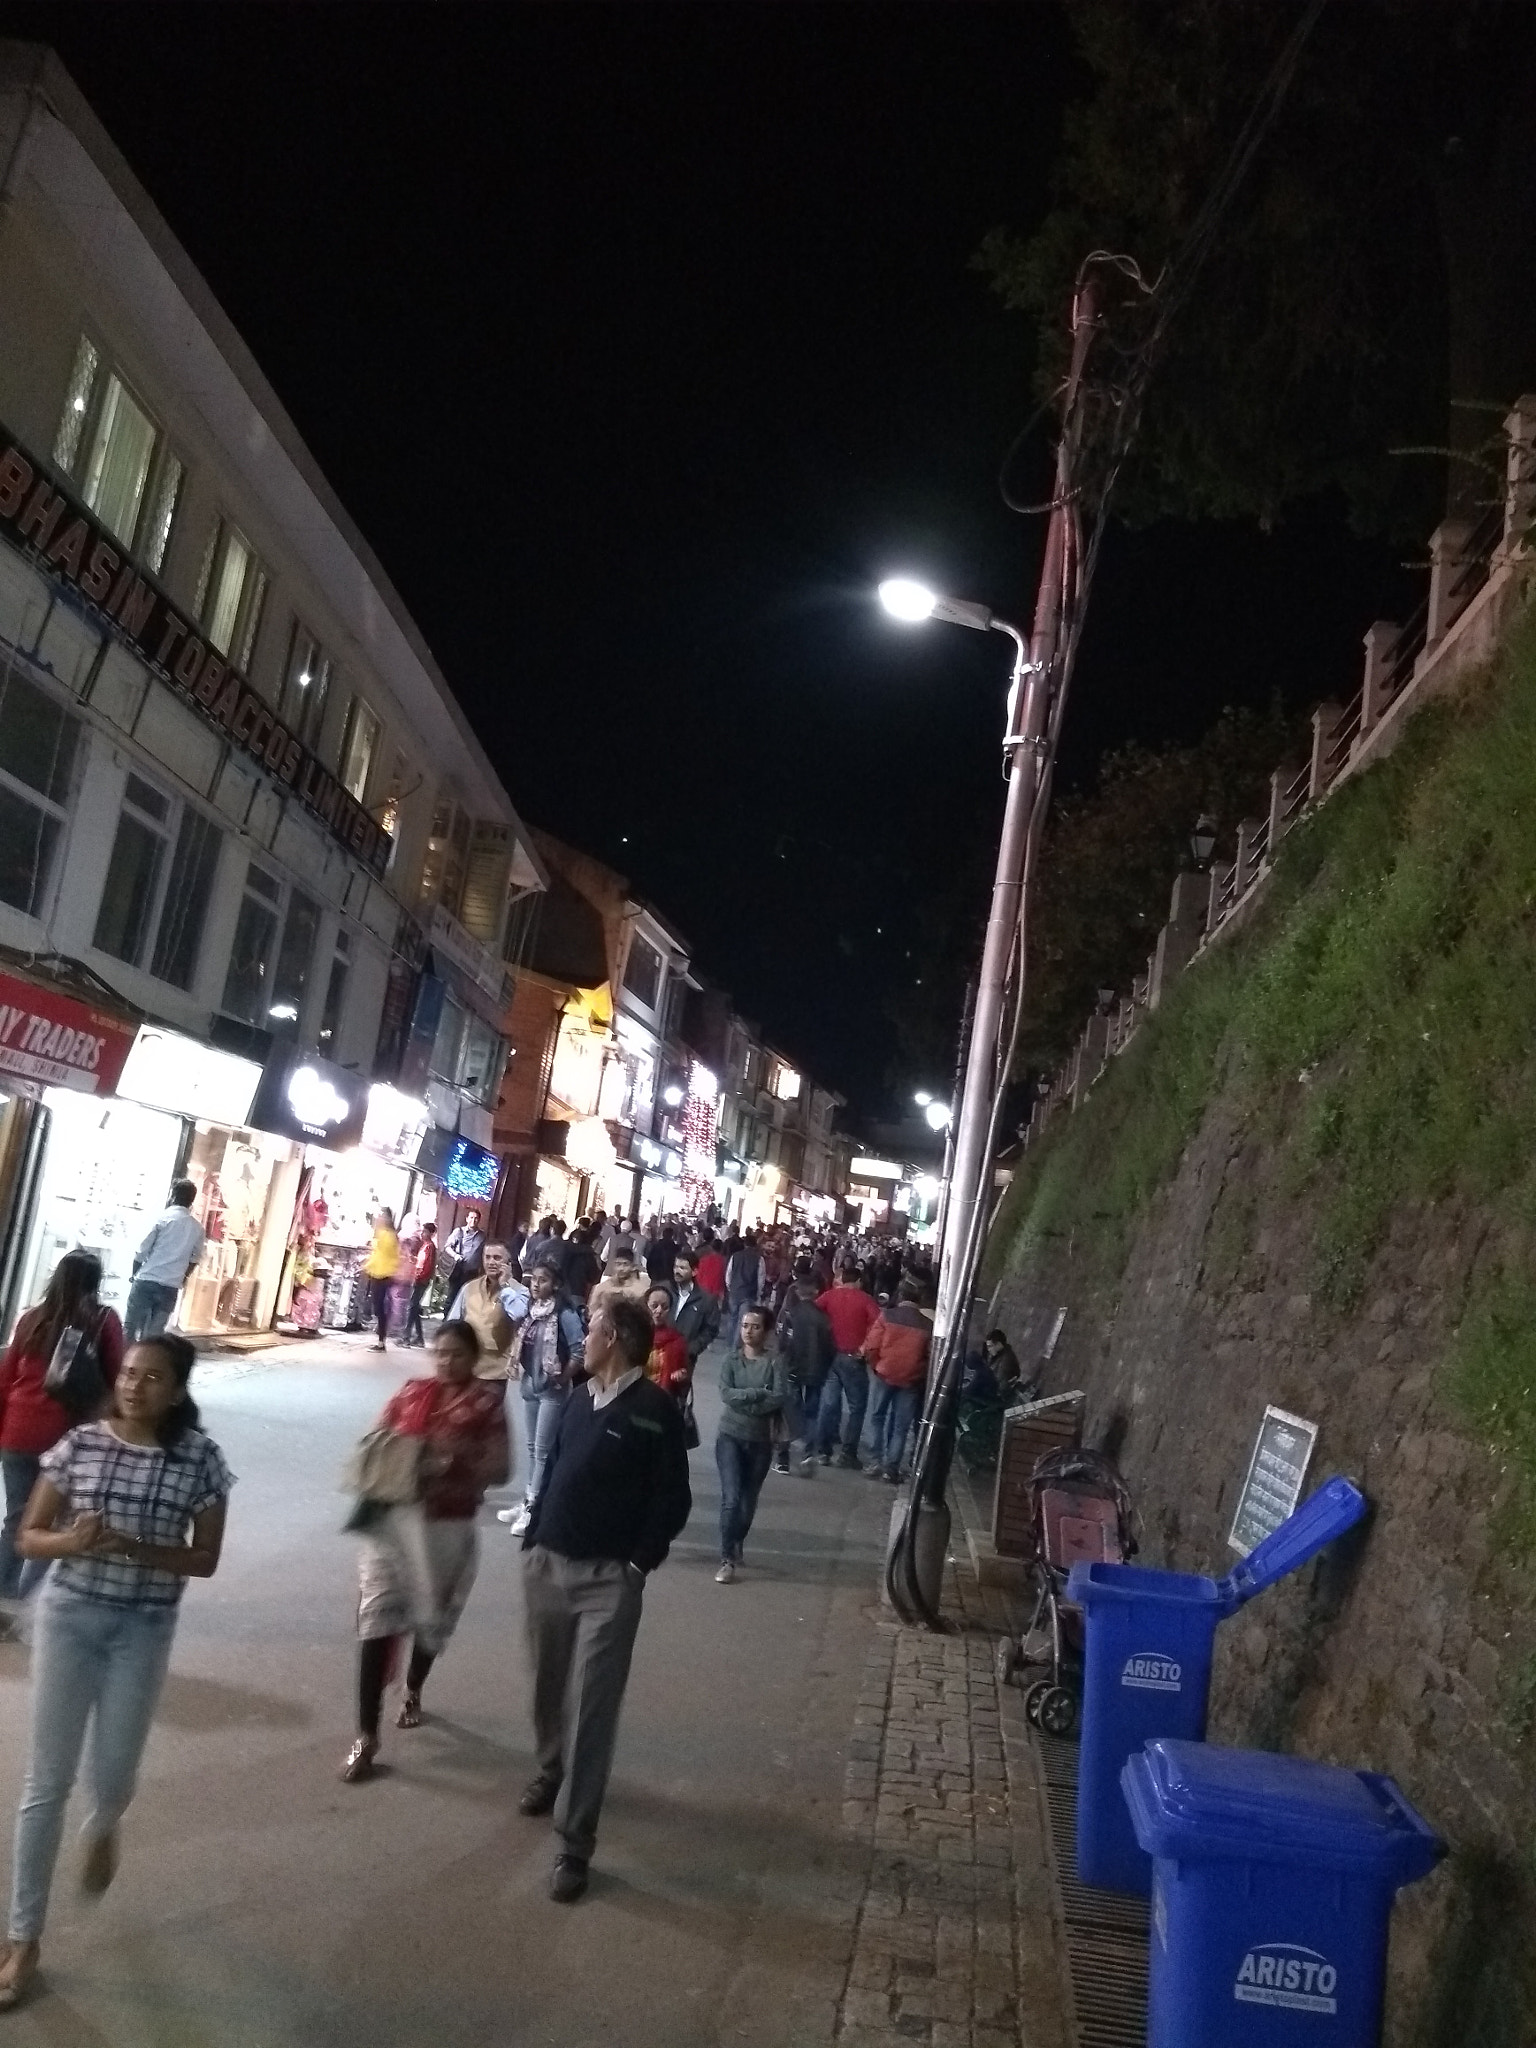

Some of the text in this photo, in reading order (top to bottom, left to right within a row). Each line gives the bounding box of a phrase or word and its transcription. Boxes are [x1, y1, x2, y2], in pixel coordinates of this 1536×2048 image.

[0, 447, 157, 636] BHASIN
[157, 610, 303, 785] TOBACCOS
[19, 1014, 107, 1070] TRADERS
[1122, 1658, 1182, 1681] ARISTO
[1236, 1953, 1337, 1994] ARISTO
